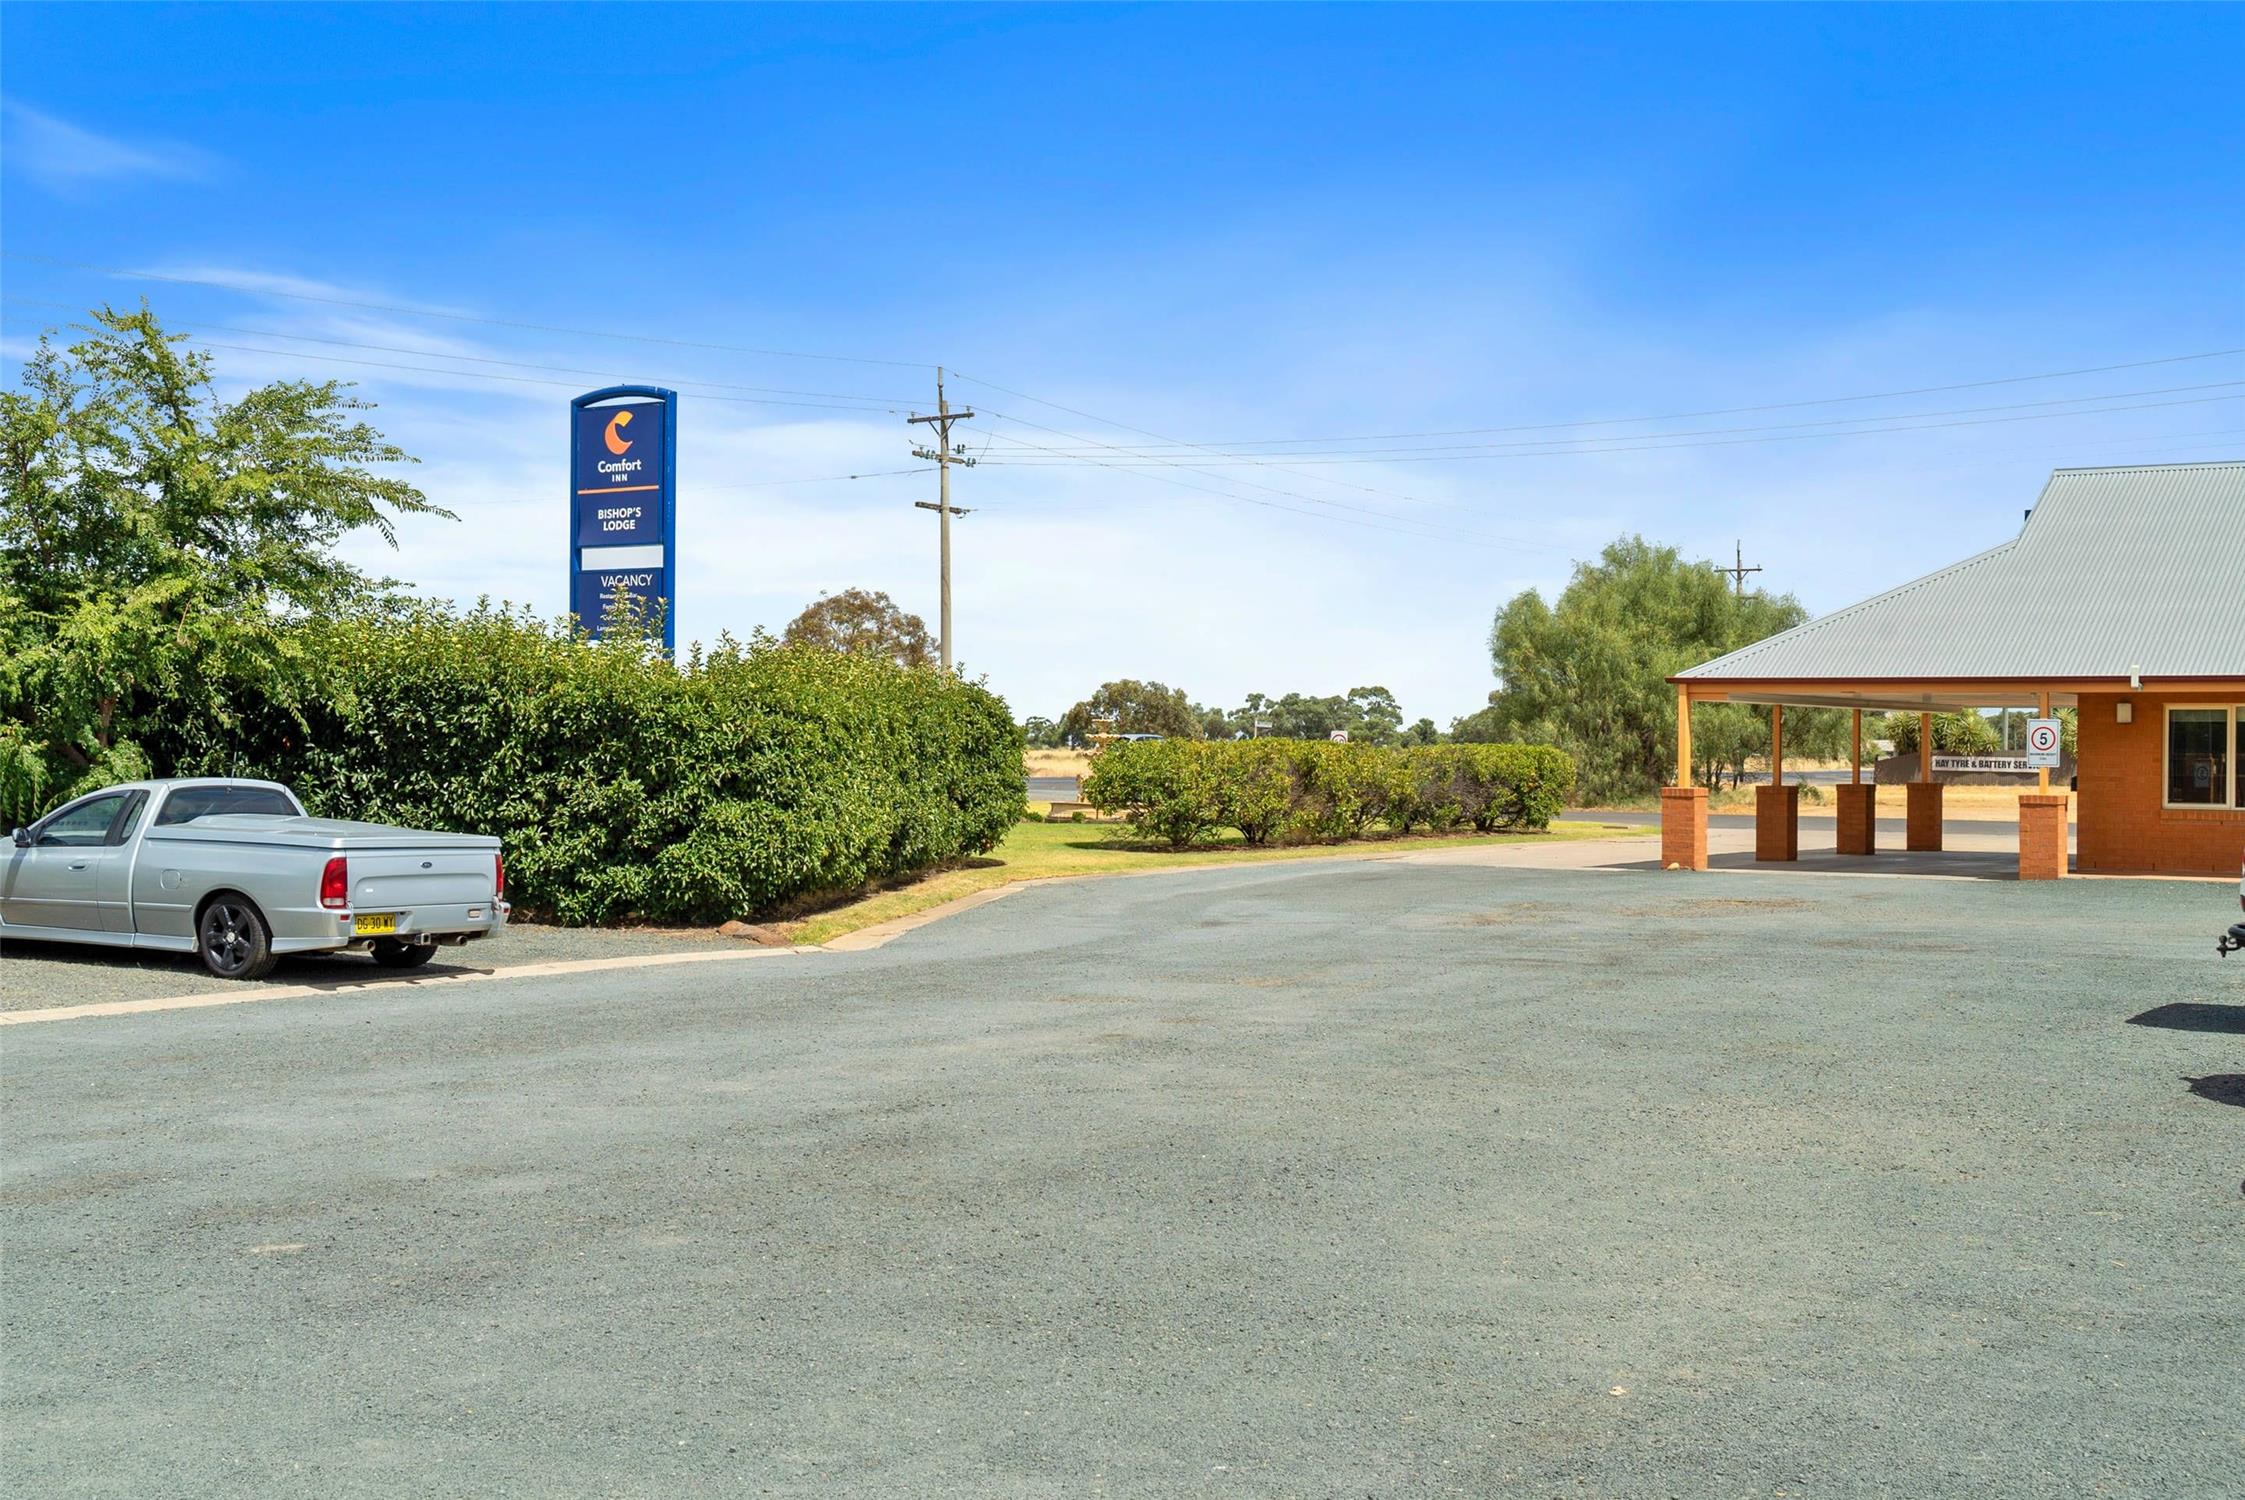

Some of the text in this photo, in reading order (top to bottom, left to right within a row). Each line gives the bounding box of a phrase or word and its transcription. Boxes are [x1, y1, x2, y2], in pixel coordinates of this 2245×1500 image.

[597, 458, 642, 473] Comfort
[611, 473, 628, 482] INN
[597, 507, 642, 520] BISHOP'S
[603, 519, 636, 531] LODGE
[600, 574, 653, 588] VACANCY
[2039, 732, 2048, 746] 5
[1935, 759, 1949, 768] HAY
[1951, 759, 1970, 769] TYRE
[1971, 760, 1977, 769] &
[1979, 760, 2012, 770] BATTERY
